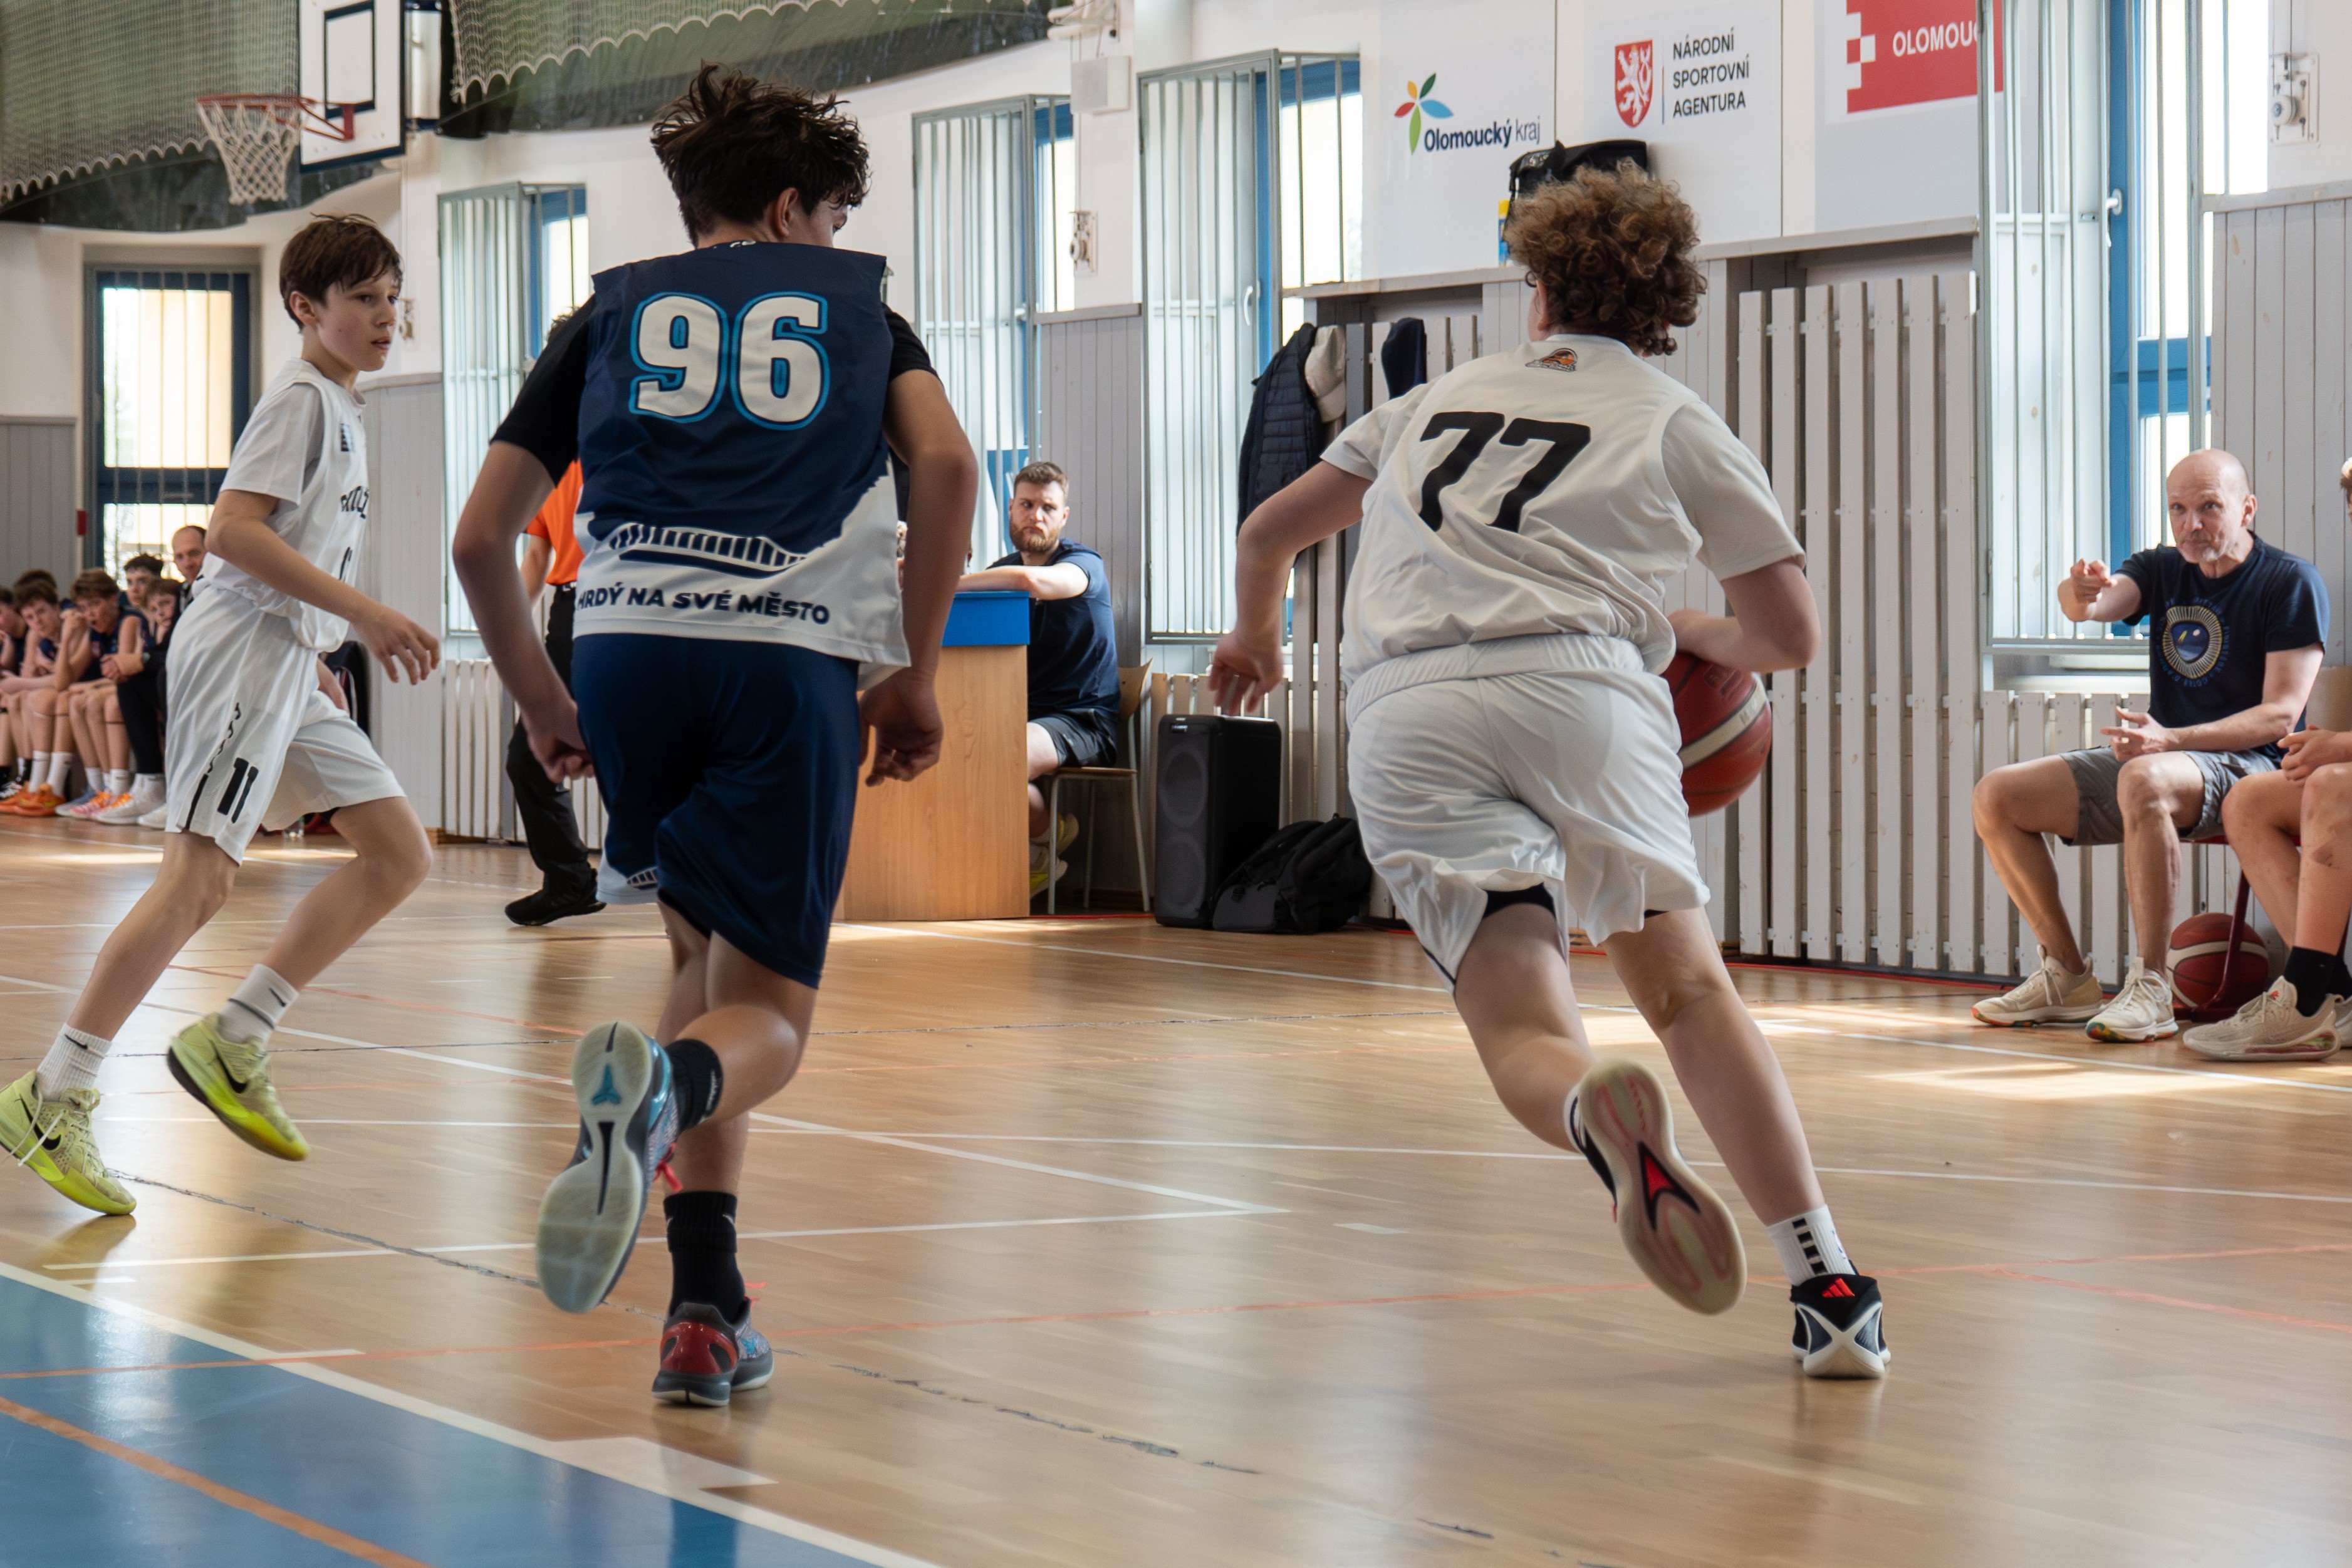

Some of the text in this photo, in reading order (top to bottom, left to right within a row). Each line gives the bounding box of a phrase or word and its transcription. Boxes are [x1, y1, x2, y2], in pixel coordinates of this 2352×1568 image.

[1673, 26, 1734, 60] NÁRODNÍ
[1893, 20, 1977, 57] OLOMOU
[1673, 53, 1749, 89] SPORTOVNÍ
[1673, 90, 1746, 118] AGENTURA
[1424, 115, 1541, 152] Olomoucký kraj
[628, 291, 830, 430] 96
[1420, 410, 1591, 532] 77
[627, 587, 665, 606] NA
[672, 589, 732, 611] SVÉ
[737, 591, 831, 625] MĚSTO
[217, 757, 259, 824] 11
